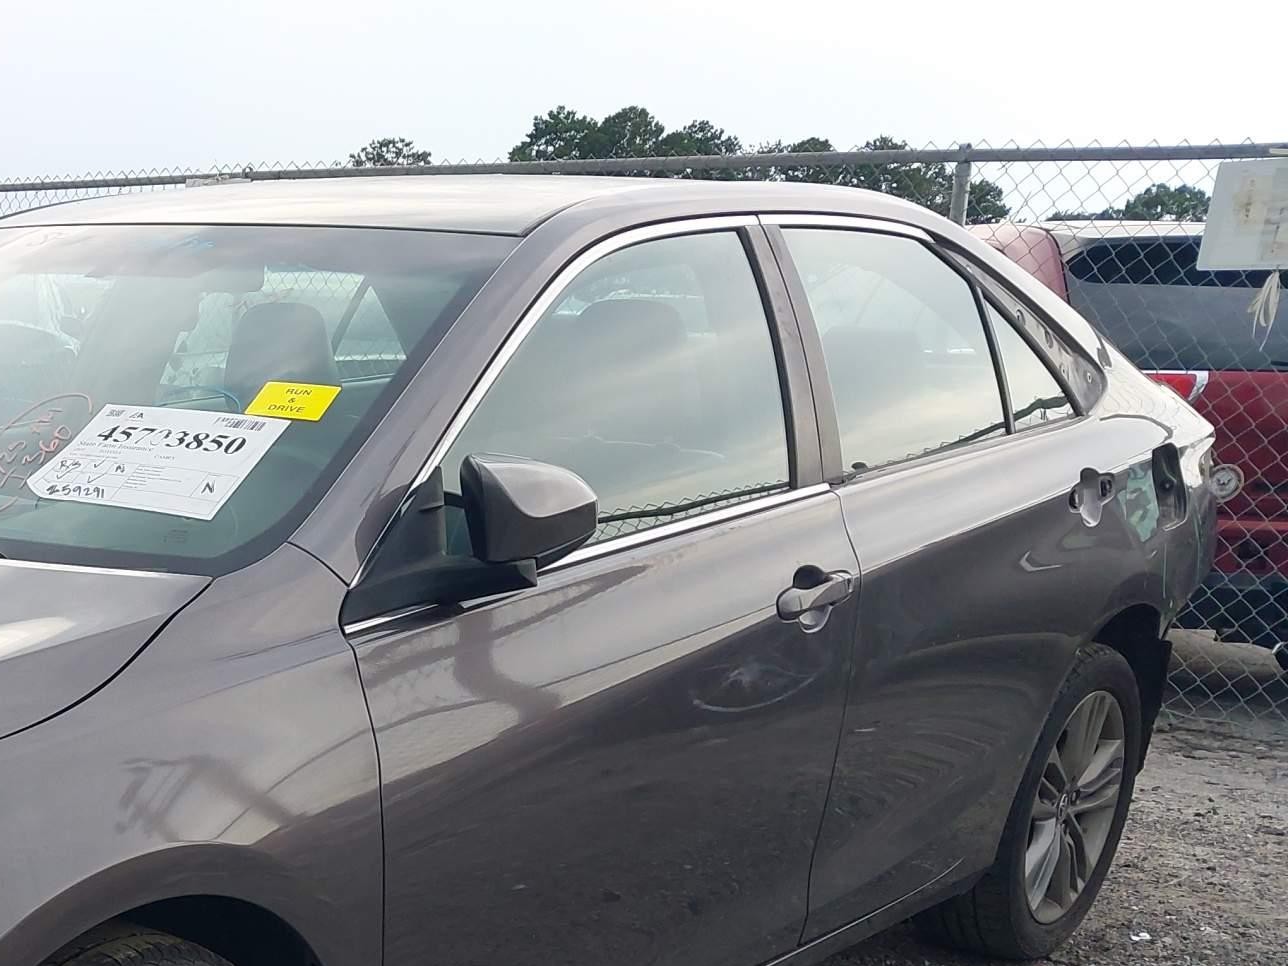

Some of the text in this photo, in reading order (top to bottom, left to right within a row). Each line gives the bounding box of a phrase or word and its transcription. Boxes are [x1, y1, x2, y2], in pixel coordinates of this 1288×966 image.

[285, 388, 313, 396] RUN
[267, 404, 305, 413] DRIVE
[200, 479, 216, 494] N
